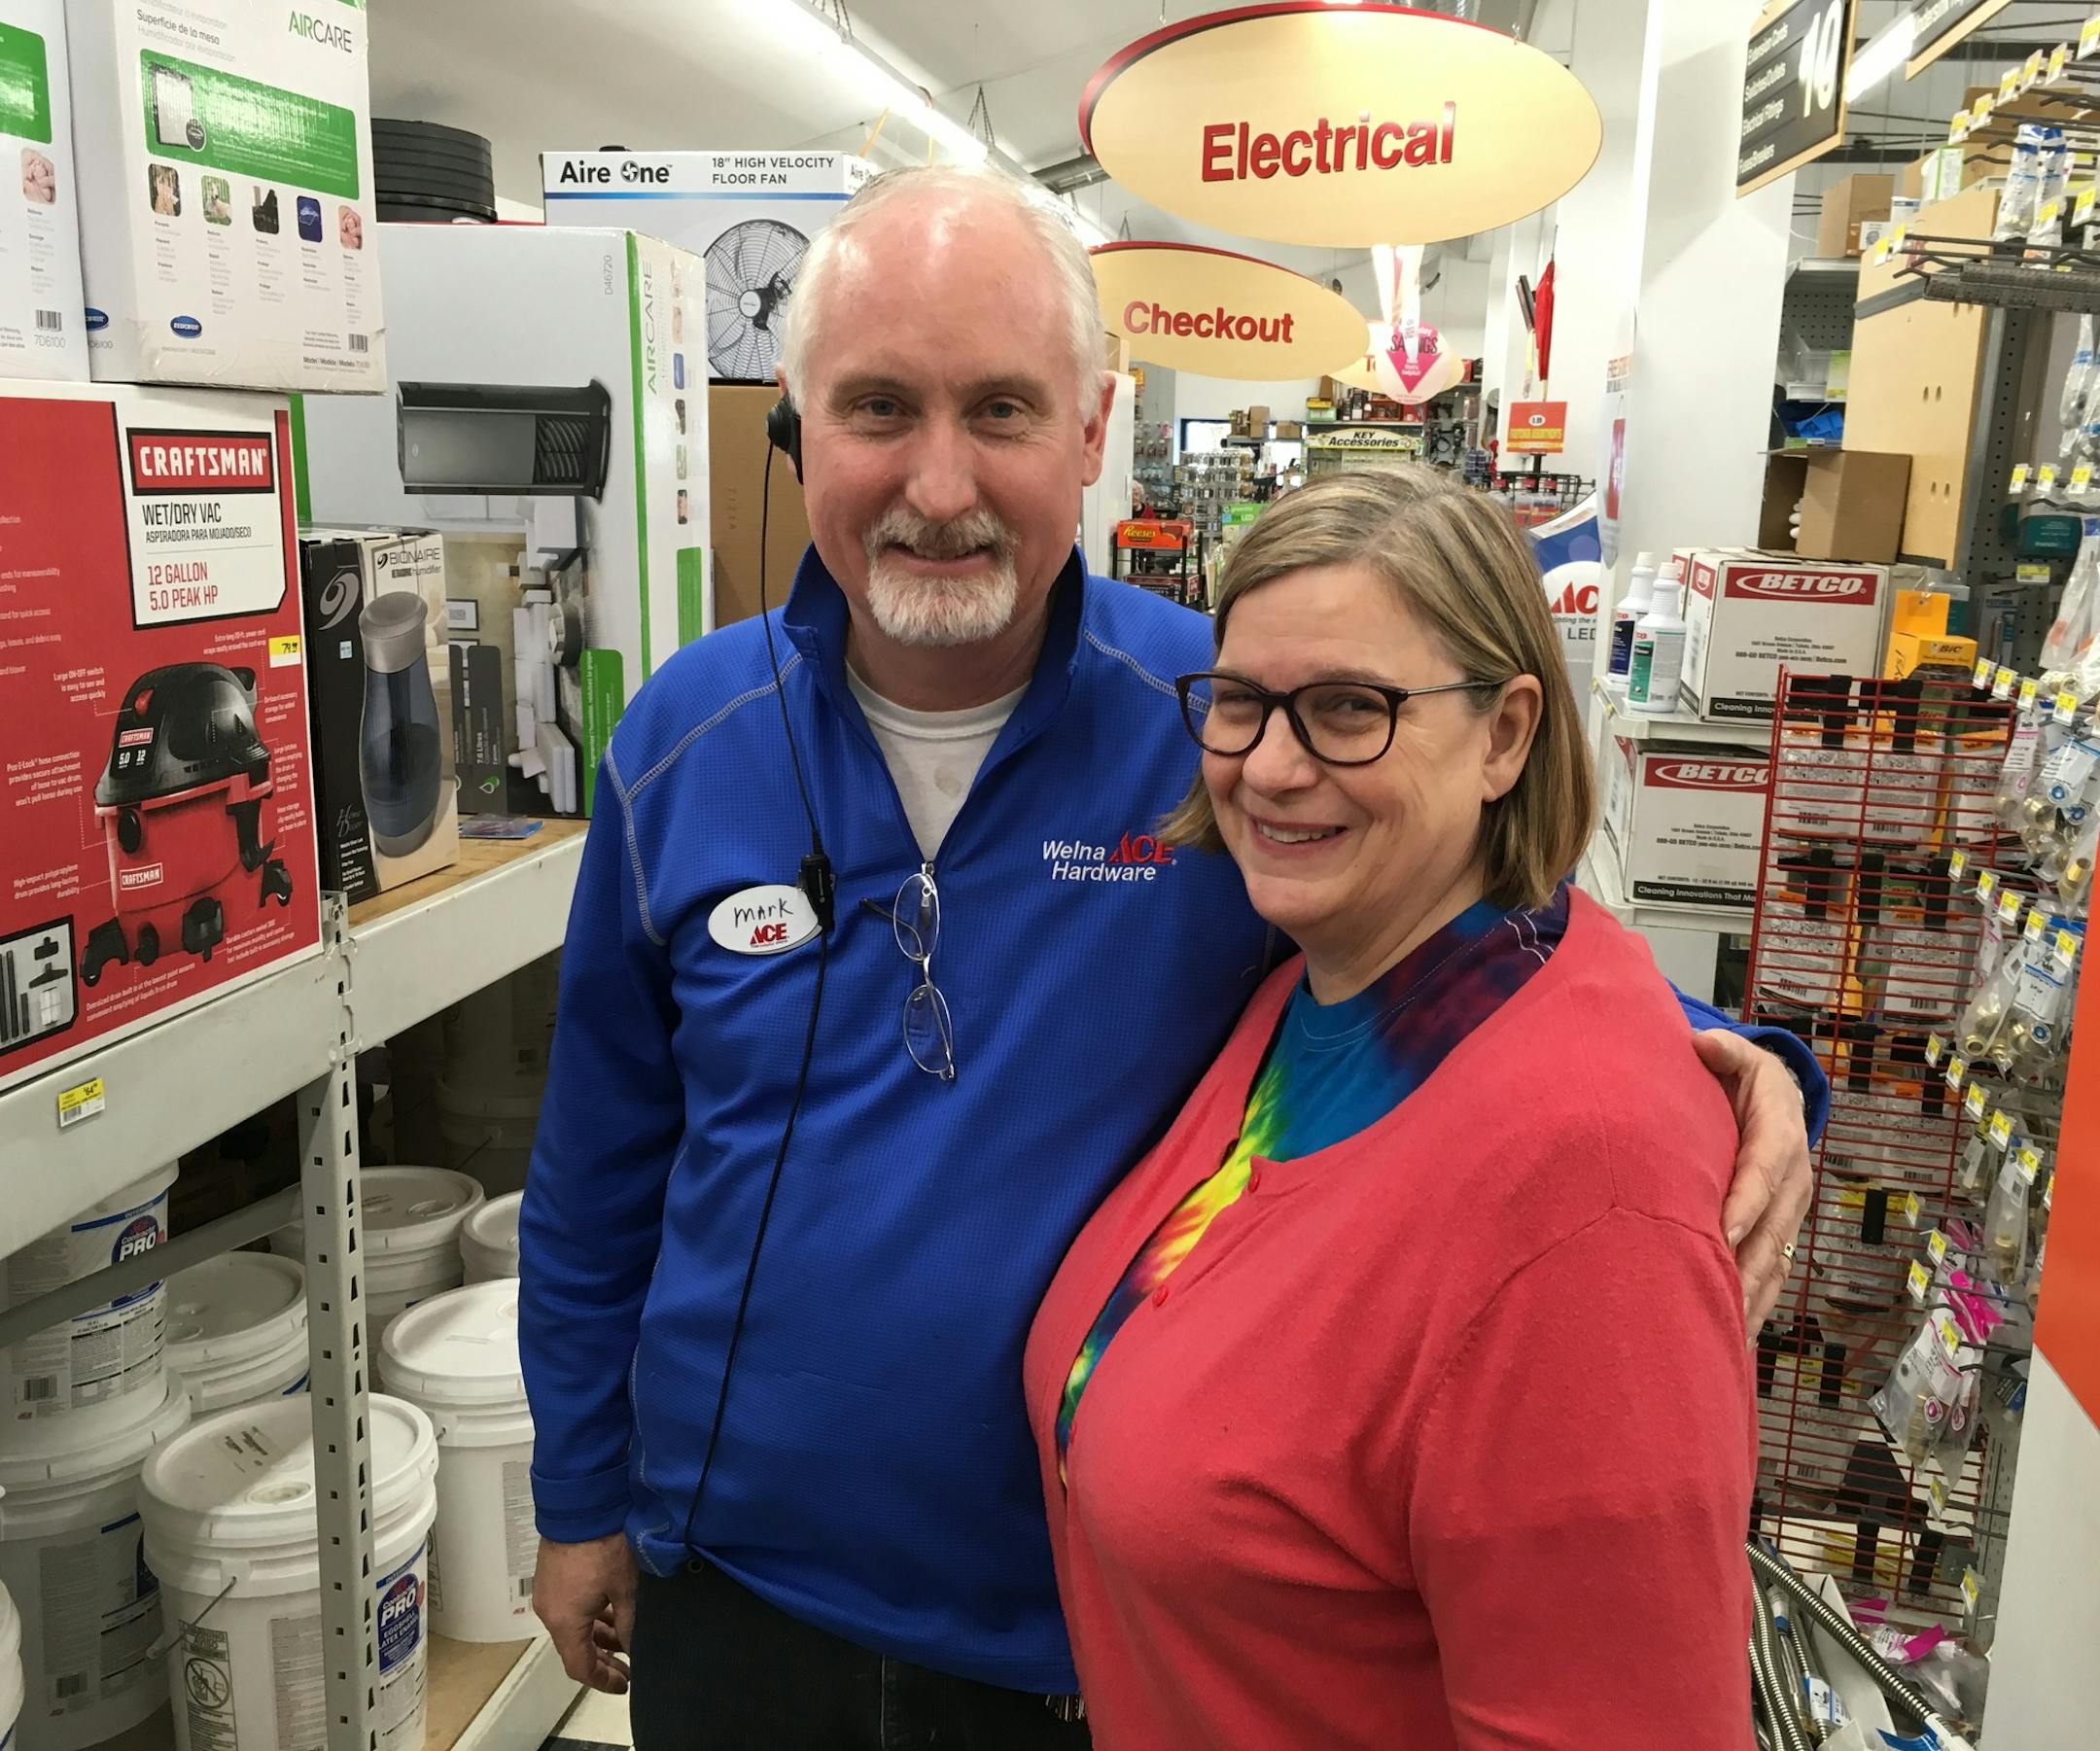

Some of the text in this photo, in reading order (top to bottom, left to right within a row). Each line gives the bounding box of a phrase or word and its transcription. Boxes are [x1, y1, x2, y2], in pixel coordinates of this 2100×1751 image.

[137, 9, 220, 45] Superficie de la mesa
[289, 10, 352, 53] AIRCARE
[1799, 0, 1841, 119] 10
[1202, 101, 1455, 182] Electrical
[560, 160, 612, 183] Aire
[735, 158, 767, 168] HIGH
[770, 158, 833, 168] VELOCITY
[712, 173, 788, 185] FLOOR FAN
[604, 255, 613, 296] D46720
[643, 261, 657, 395] AIRCARE
[1123, 300, 1294, 344] Checkout
[34, 333, 66, 348] 7D6100
[88, 340, 114, 350] D6100
[1329, 437, 1400, 447] Accessories
[140, 446, 263, 476] CRAFTSMAN
[142, 503, 222, 526] WET/DRY VAC
[146, 528, 190, 543] ASPIRADORA
[192, 527, 208, 541] PARA
[1123, 525, 1156, 538] Reese's
[148, 561, 208, 585] 12 GALLON
[1758, 574, 1863, 593] BETCO
[150, 585, 218, 611] 5.0 PEAK HP
[1714, 701, 1753, 714] Cleaning
[119, 750, 146, 765] 5.0 12
[1042, 831, 1174, 864] Welna ACE
[122, 868, 160, 887] CRAFTSMAN
[1052, 861, 1156, 882] Hardware
[1637, 886, 1741, 901] Cleaning Innovations That
[750, 923, 788, 945] ACE
[120, 1232, 157, 1262] PRO
[380, 1588, 416, 1628] PRO
